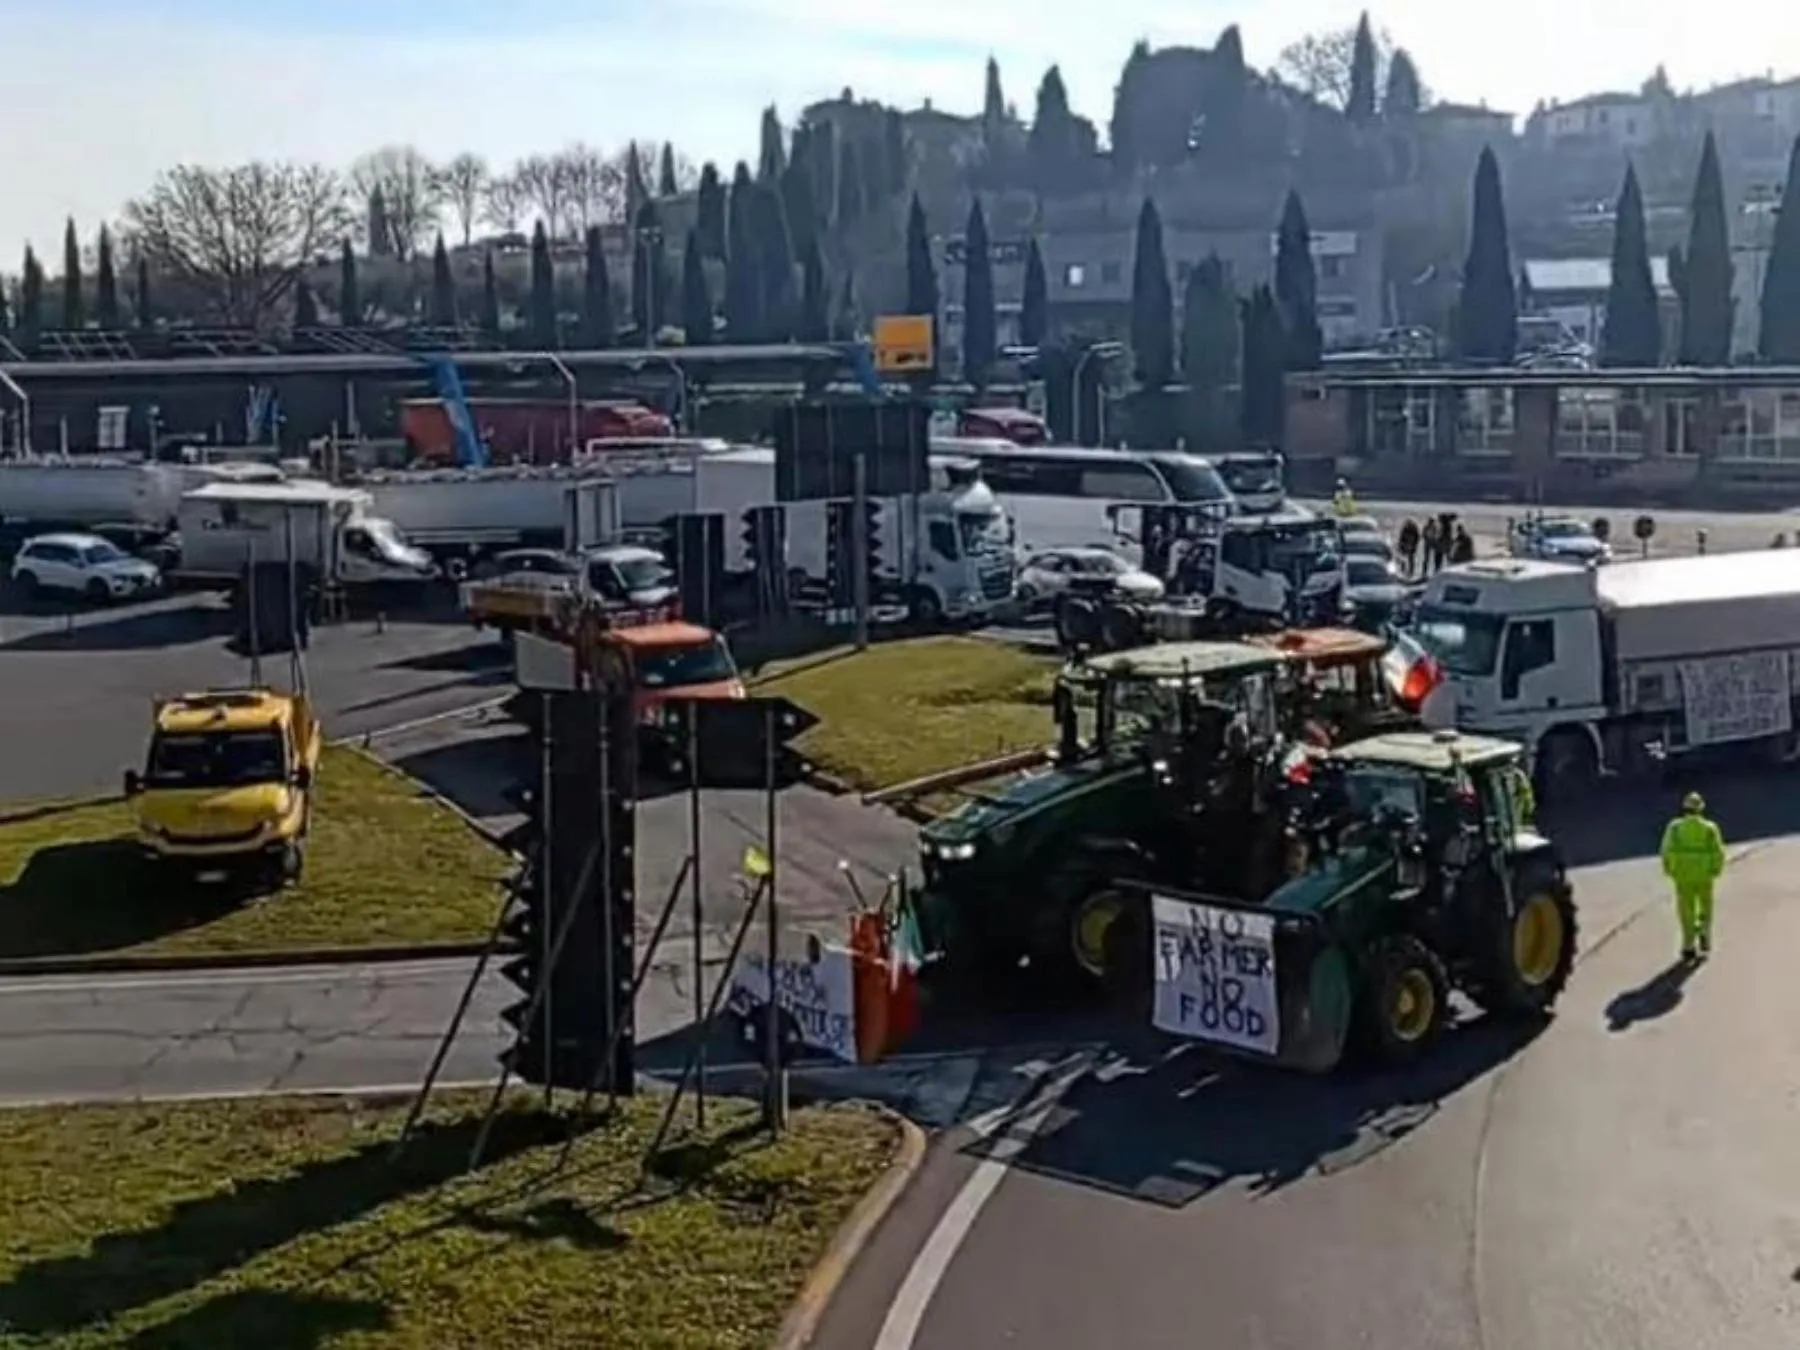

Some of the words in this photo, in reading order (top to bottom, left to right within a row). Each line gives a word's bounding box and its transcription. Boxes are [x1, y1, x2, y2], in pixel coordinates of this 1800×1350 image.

[1189, 908, 1244, 941] NO
[1159, 927, 1272, 981] FARMER
[1200, 968, 1244, 1003] NO
[1180, 992, 1265, 1038] FOOD
